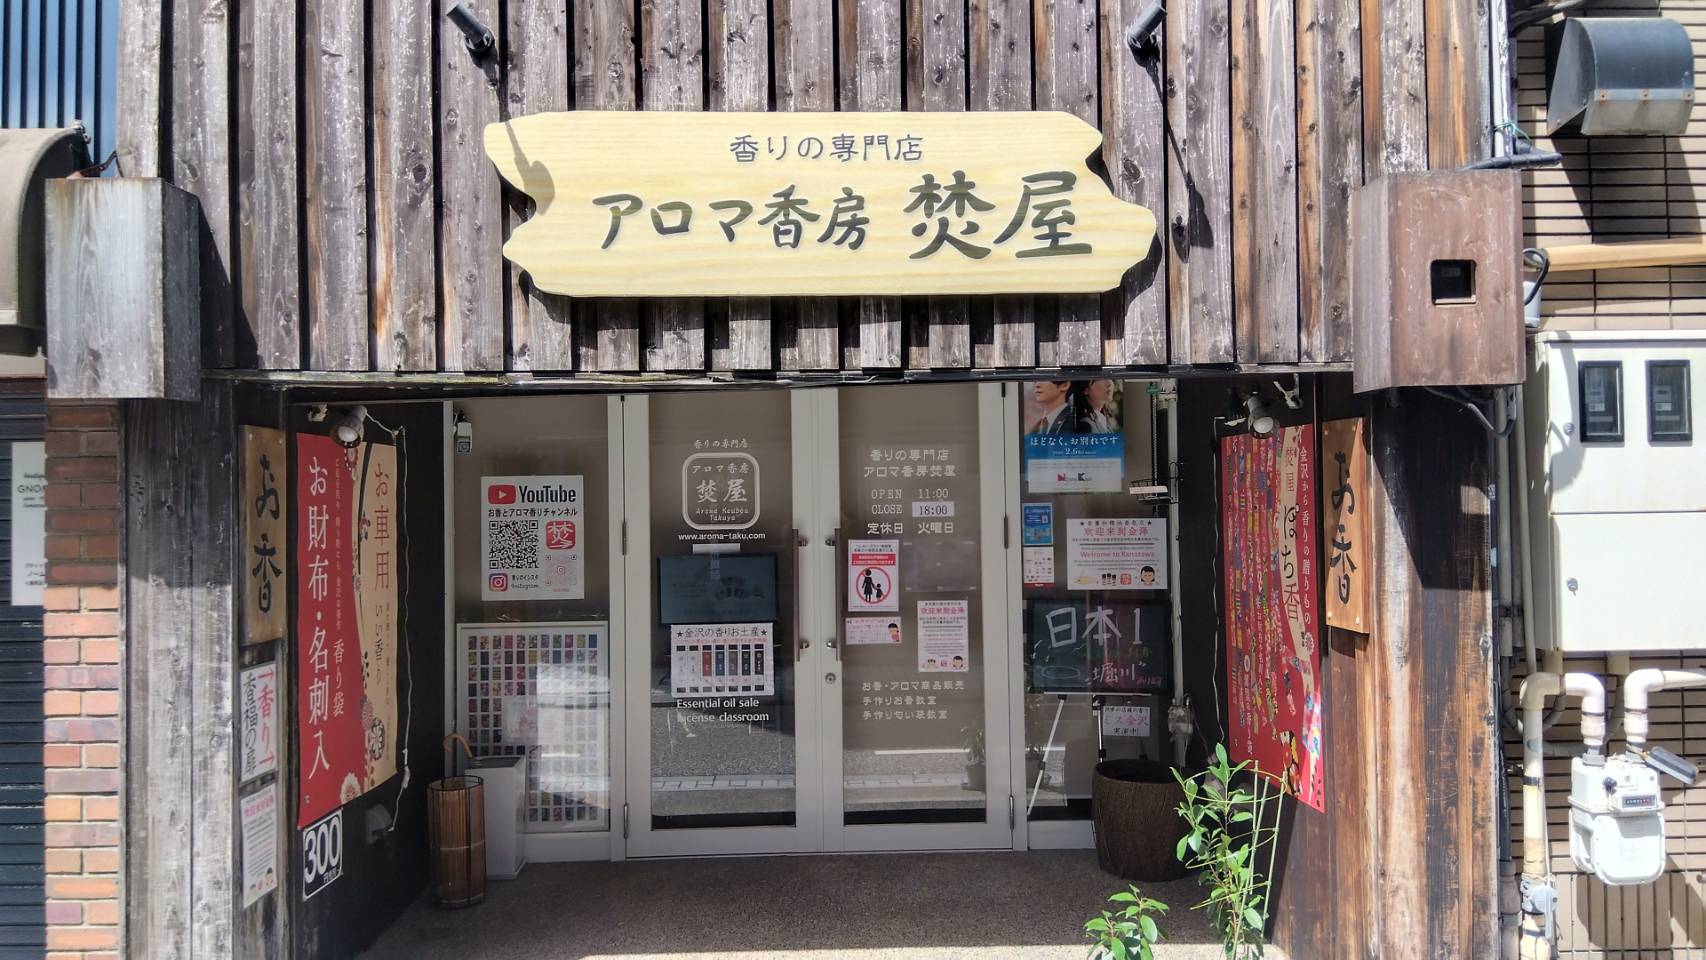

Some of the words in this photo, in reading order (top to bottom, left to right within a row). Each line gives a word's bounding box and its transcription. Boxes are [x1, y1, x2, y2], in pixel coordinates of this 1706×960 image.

[729, 134, 924, 162] 香りの専門店
[592, 184, 870, 251] アロマ香房
[903, 170, 1093, 260] 焚屋
[694, 438, 748, 449] 香りの専門店
[1030, 436, 1118, 446] ほどなく、お別れです
[870, 449, 950, 462] 香りの専門店
[692, 462, 749, 474] アロマ香房
[863, 465, 956, 478] アロマ香房焚屋
[17, 484, 45, 493] GNO
[519, 485, 577, 503] YouTube
[696, 479, 747, 503] 焚屋
[871, 488, 902, 499] OPEN
[918, 488, 949, 499] 11:00
[488, 507, 578, 518] お香とアロマ香りチャンネル
[871, 504, 903, 514] CLOSE
[919, 505, 948, 516] 18:00
[252, 454, 283, 614] お香
[867, 522, 904, 534] 定休日
[917, 522, 954, 534] 火曜日
[1329, 451, 1357, 605] お香
[678, 532, 766, 541] www.aroma-taku.com
[1299, 446, 1313, 625] 金沢から香りの贈りもの
[862, 680, 965, 691] お香・アロマ商品販売
[676, 697, 721, 709] Essential
[723, 697, 736, 708] oil
[738, 697, 760, 708] sale
[718, 711, 769, 722] classroom
[305, 816, 341, 884] 300
